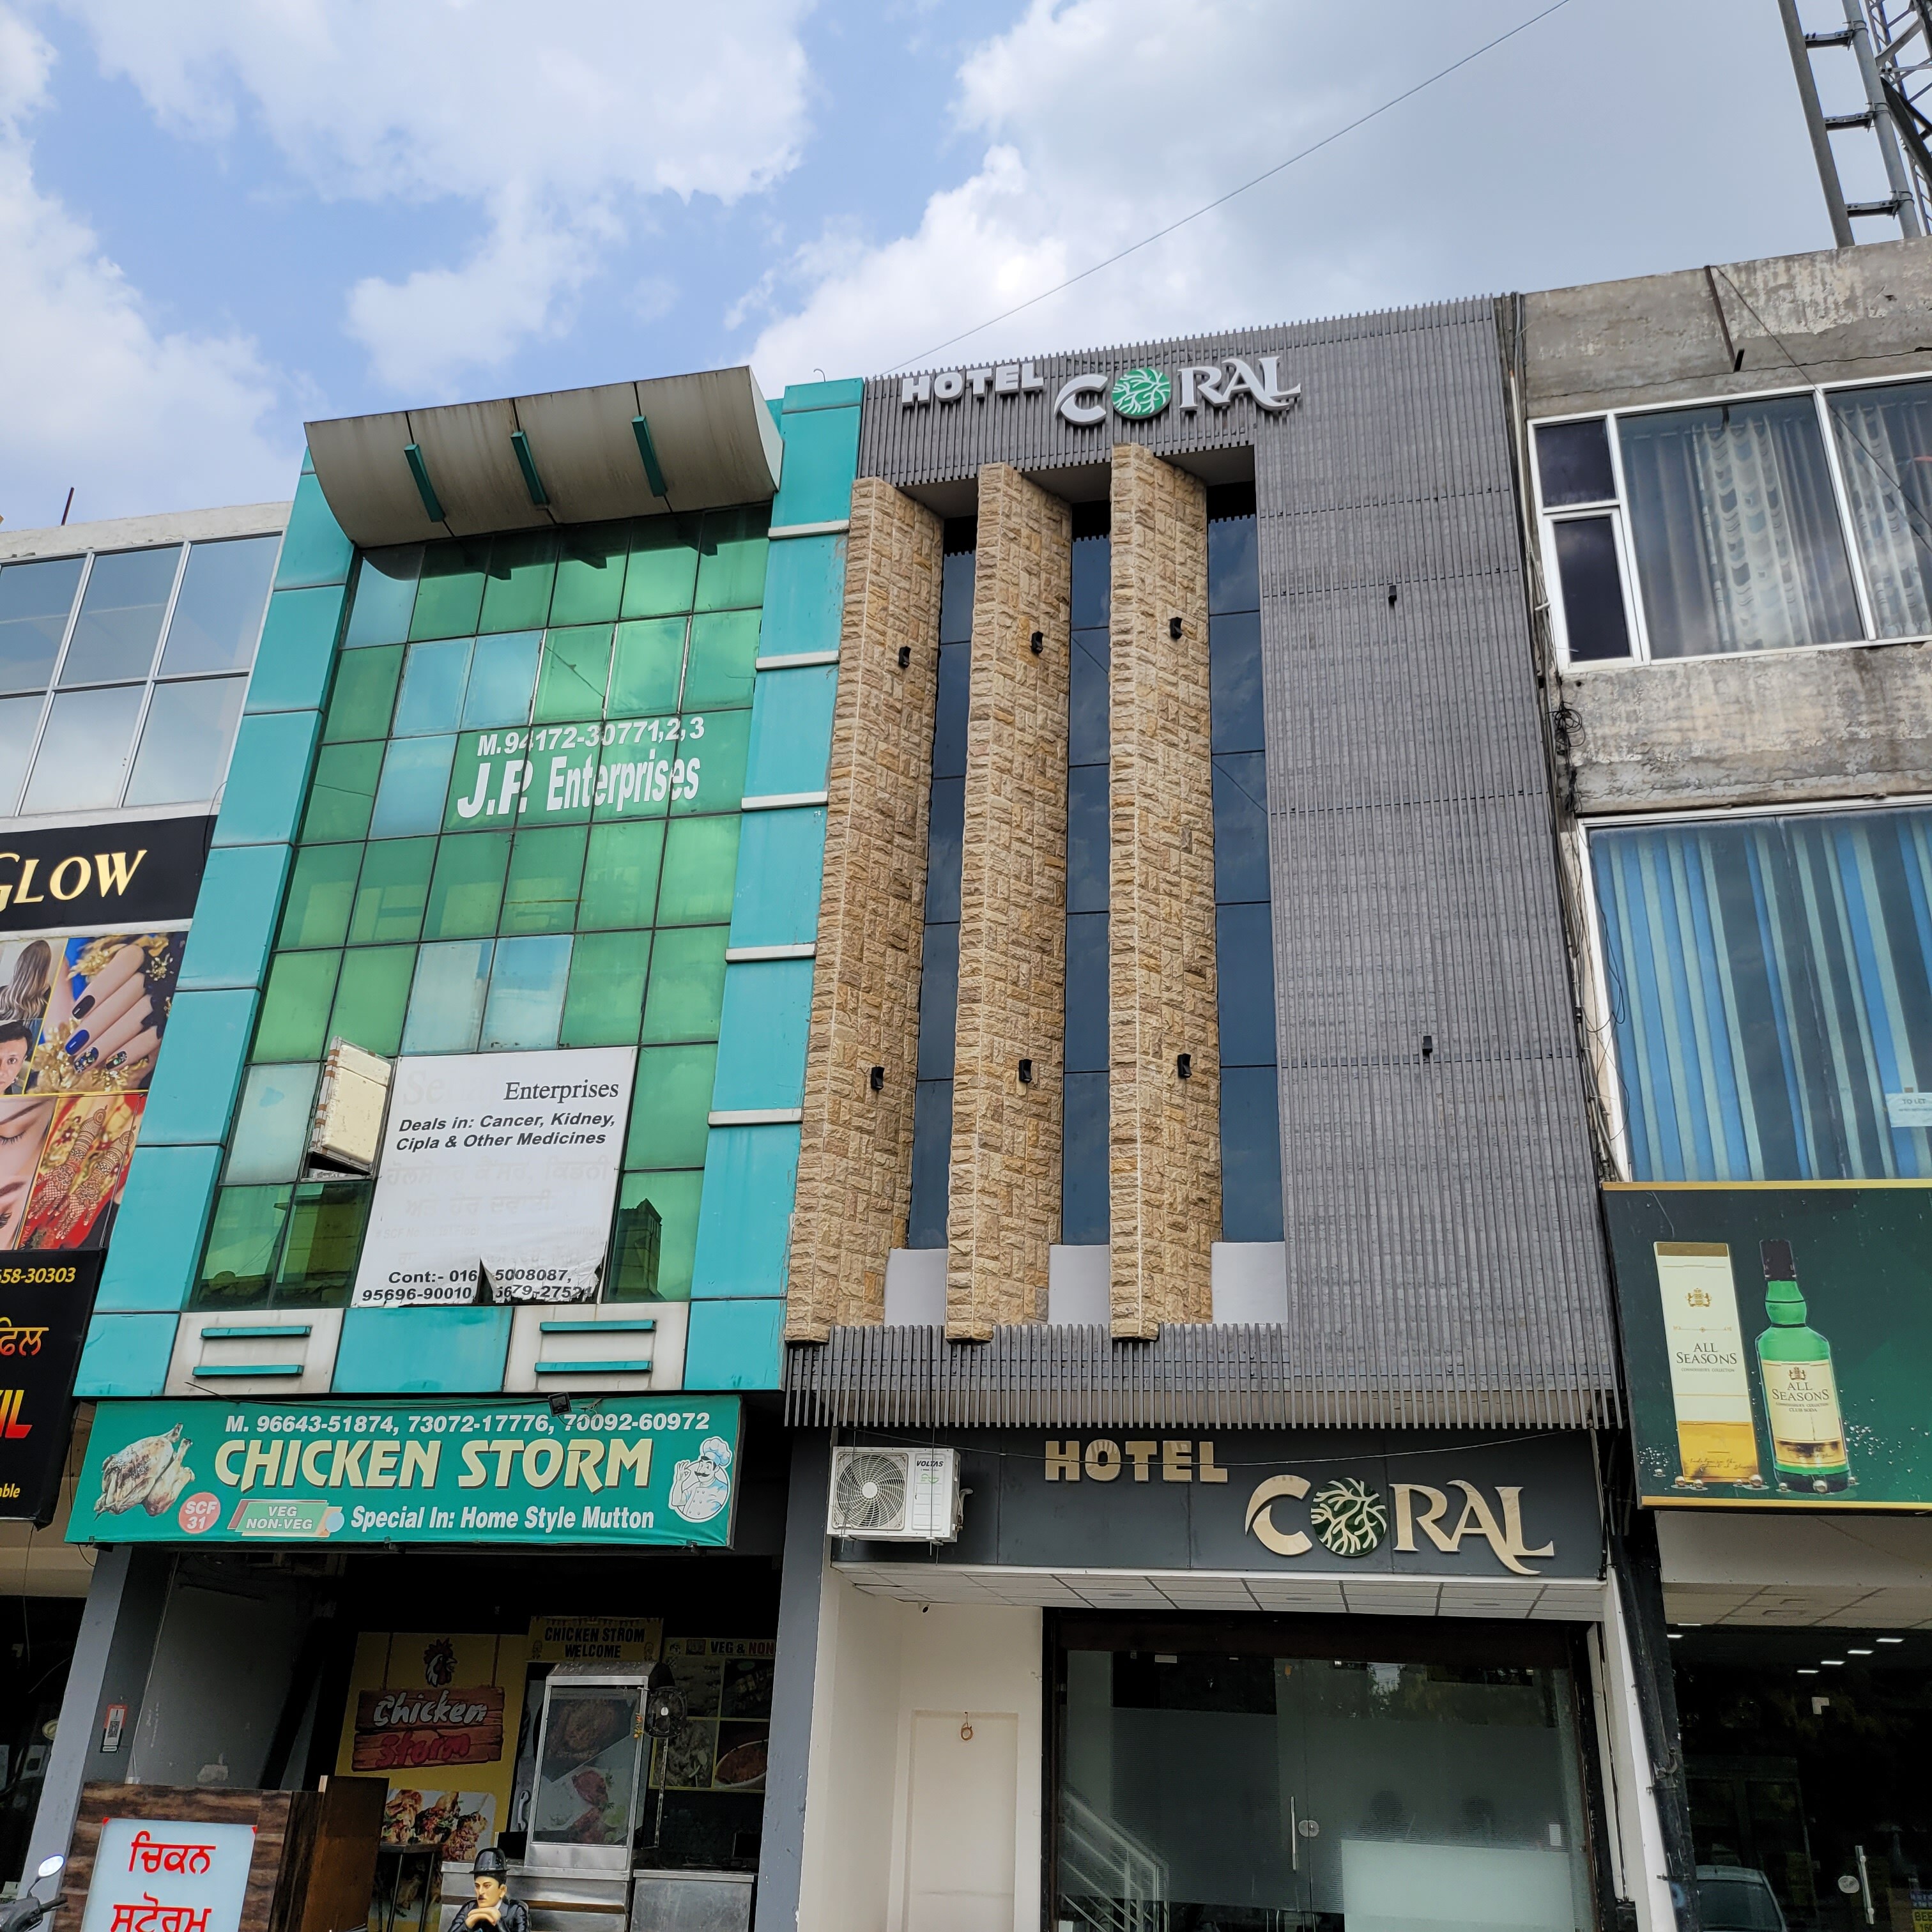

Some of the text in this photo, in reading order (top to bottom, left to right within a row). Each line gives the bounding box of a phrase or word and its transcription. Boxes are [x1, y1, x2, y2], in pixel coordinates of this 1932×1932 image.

[901, 361, 1045, 406] HOTEL
[546, 749, 701, 812] Enterprises
[503, 1079, 619, 1104] Enterprises
[399, 1112, 615, 1132] Deals in: Cancer, Kidney,
[396, 1131, 606, 1153] Cipla & Other Medicines
[0, 1268, 77, 1284] 58-30303
[1693, 1342, 1718, 1353] ALL
[1676, 1352, 1737, 1365] SEASONS
[1772, 1388, 1829, 1401] SEASONS
[1787, 1382, 1813, 1391] ALL
[256, 1415, 399, 1436] 96643-51874,
[408, 1414, 555, 1434] 73072-17776,
[563, 1412, 710, 1432] 70092-60972
[215, 1438, 654, 1494] CHICKEN STORM
[1044, 1439, 1229, 1484] HOTEL
[185, 1501, 218, 1515] SCF
[268, 1506, 298, 1517] VEG
[187, 1516, 206, 1529] 31
[245, 1518, 312, 1529] NON-VEG
[351, 1505, 425, 1533] Special
[460, 1506, 519, 1528] Home
[524, 1505, 576, 1533] Style
[581, 1506, 654, 1528] Mutton
[544, 1627, 645, 1643] CHICKEN STROM
[564, 1643, 622, 1658] WELCOME
[710, 1641, 734, 1655] VEG
[736, 1643, 746, 1654] &
[374, 1689, 487, 1727] Chicken
[128, 1830, 216, 1874] ਚਿਕਨ
